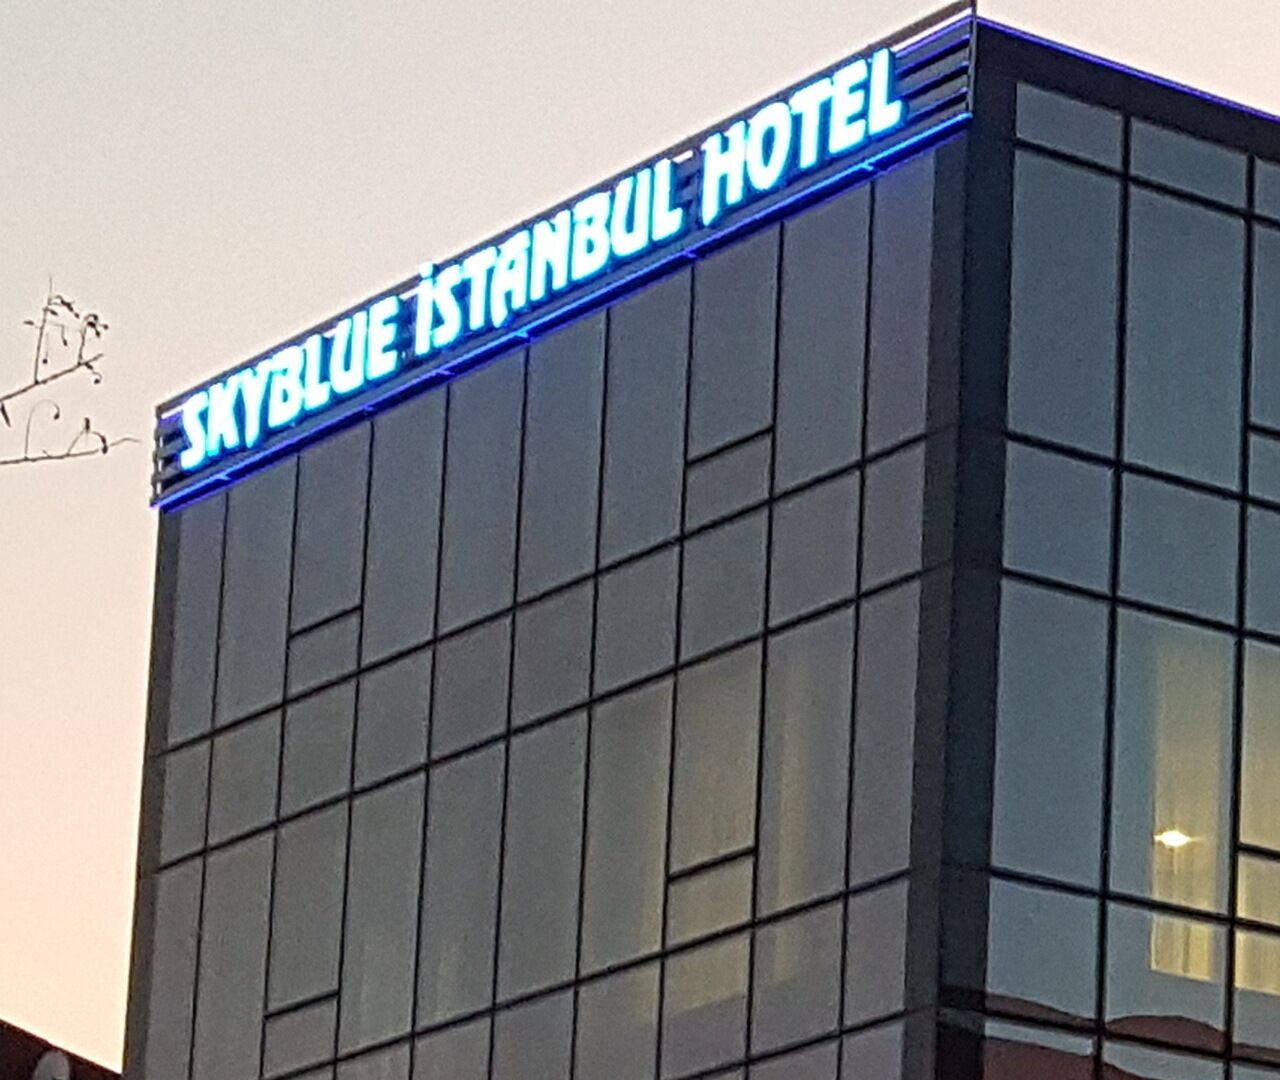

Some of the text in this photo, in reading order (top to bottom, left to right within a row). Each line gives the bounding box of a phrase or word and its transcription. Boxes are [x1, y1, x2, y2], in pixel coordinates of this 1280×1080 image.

[178, 47, 905, 471] SKYBLUE İSTANBUL HOTEL
